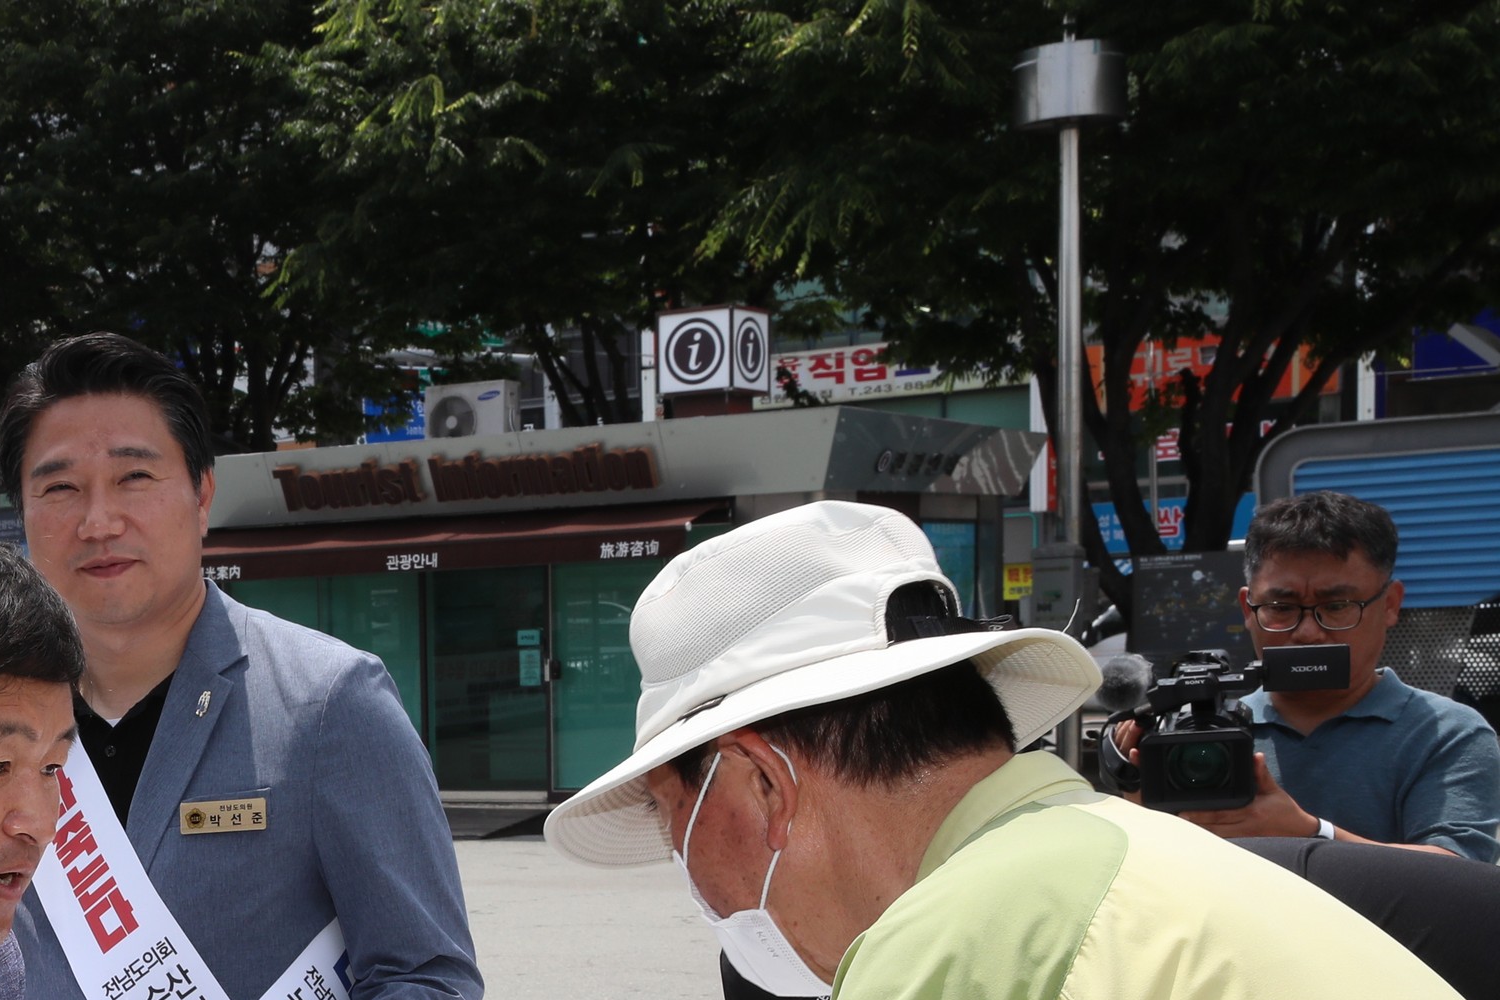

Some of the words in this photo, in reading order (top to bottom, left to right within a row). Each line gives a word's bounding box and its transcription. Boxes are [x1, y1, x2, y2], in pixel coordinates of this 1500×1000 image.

[272, 457, 426, 512] Tourist
[428, 442, 660, 502] Information
[600, 539, 659, 560] 旅游咨询
[386, 552, 438, 571] 관광안내
[200, 565, 241, 581] 光案内
[1291, 665, 1327, 673] XDCAM
[219, 803, 253, 812] 전남도의원
[101, 936, 178, 1000] 전남도의회
